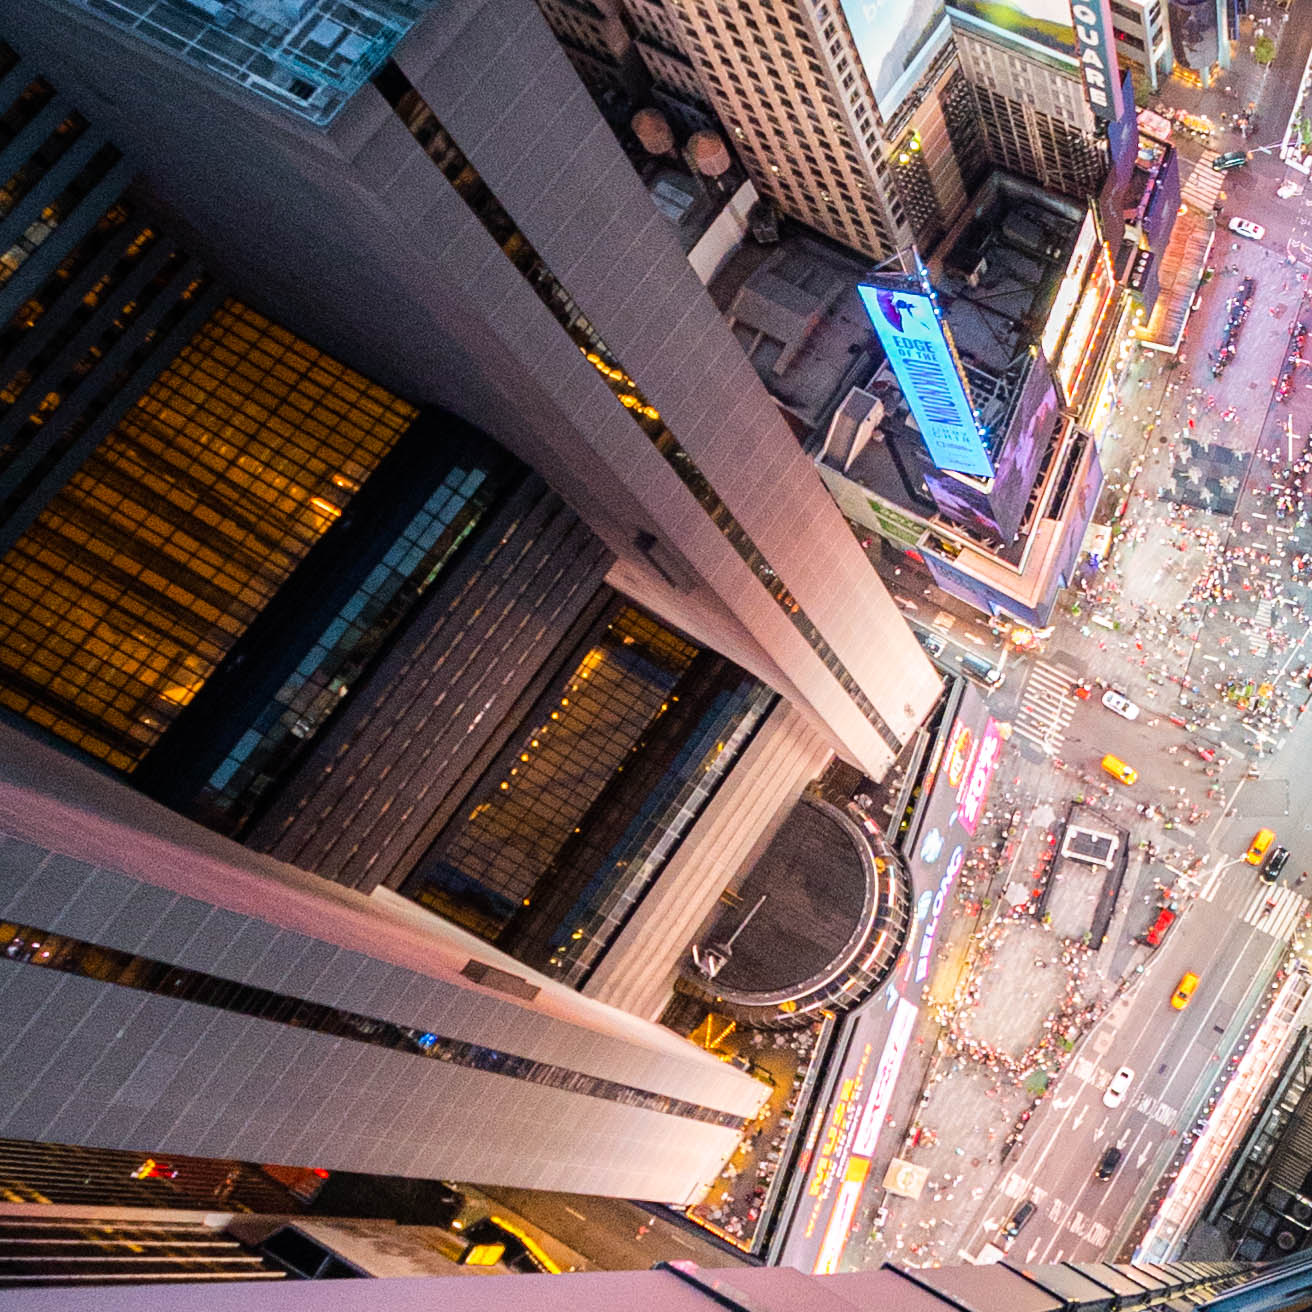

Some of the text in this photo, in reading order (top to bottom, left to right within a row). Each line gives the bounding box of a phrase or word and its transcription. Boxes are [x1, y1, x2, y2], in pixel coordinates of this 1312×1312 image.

[892, 334, 935, 354] EDGE
[899, 349, 938, 362] OF THE
[902, 357, 964, 428] UNKNOWN
